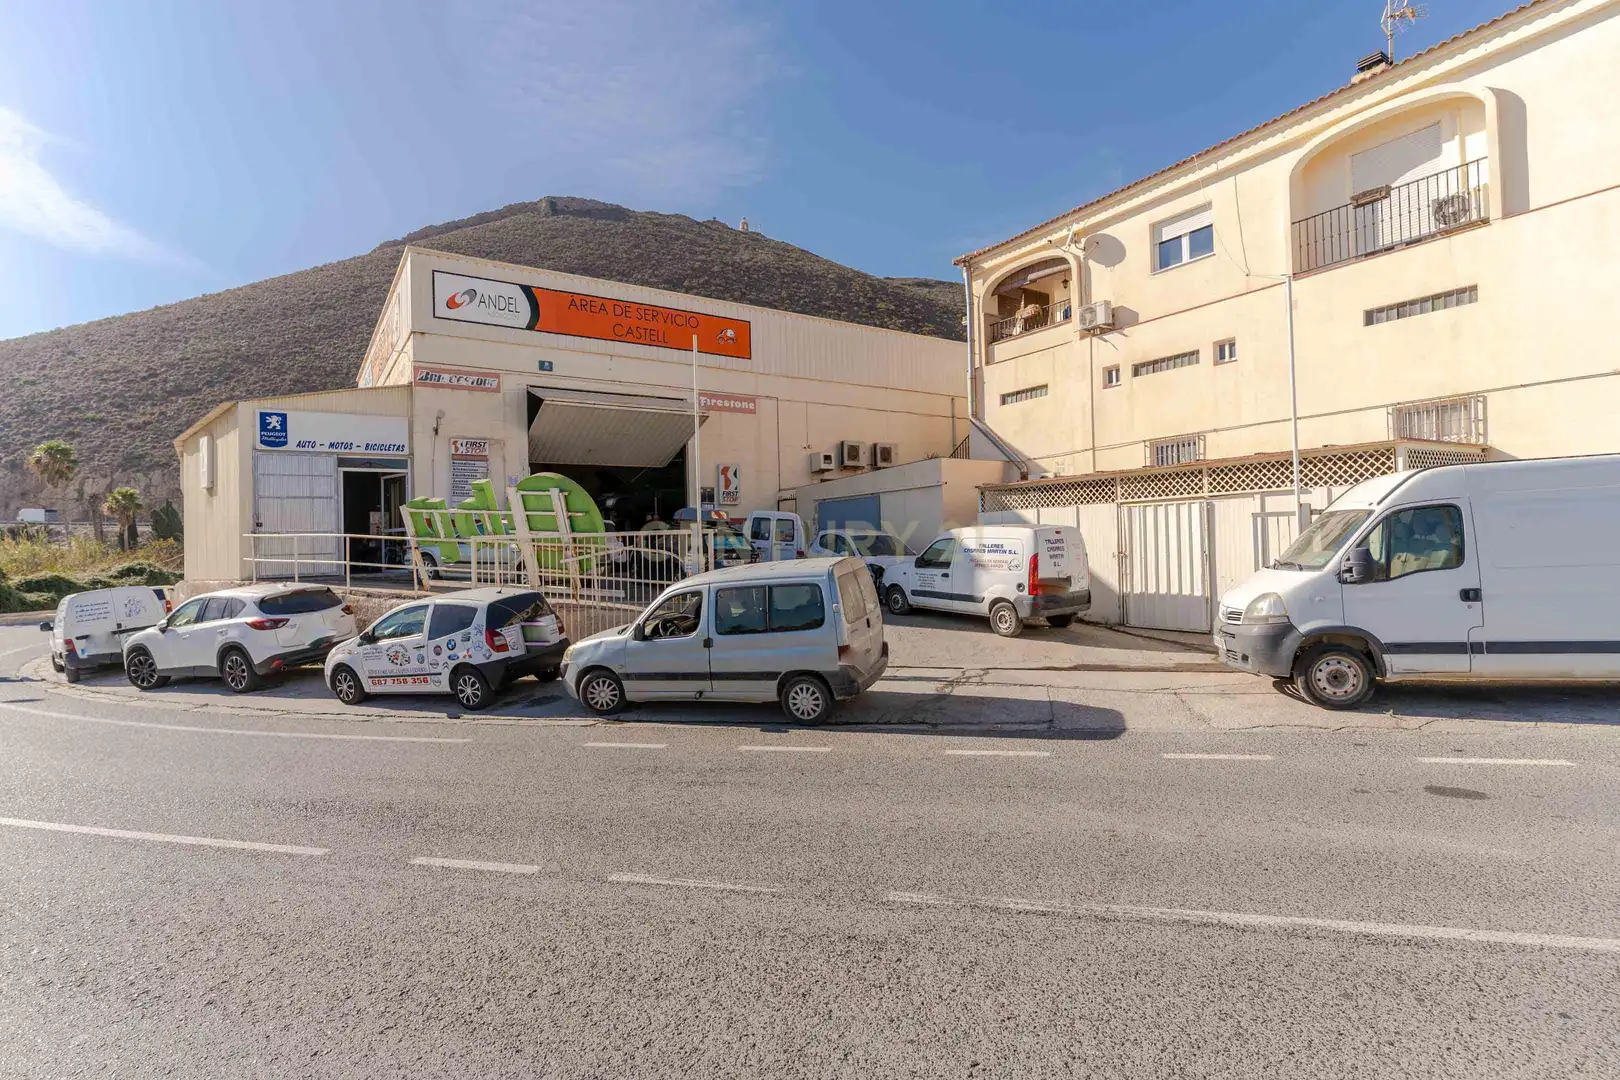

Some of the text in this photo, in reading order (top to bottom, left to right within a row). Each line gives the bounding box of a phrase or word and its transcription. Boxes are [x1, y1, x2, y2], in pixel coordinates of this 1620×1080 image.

[477, 293, 520, 314] ANDEL
[568, 295, 699, 329] ÁREA DE SERVICIO
[612, 323, 669, 344] CASTELL
[700, 396, 755, 410] Firestone
[296, 440, 316, 449] AUTO
[328, 442, 353, 450] MOTOS
[364, 443, 405, 452] BICICLETAS
[410, 676, 429, 684] 356
